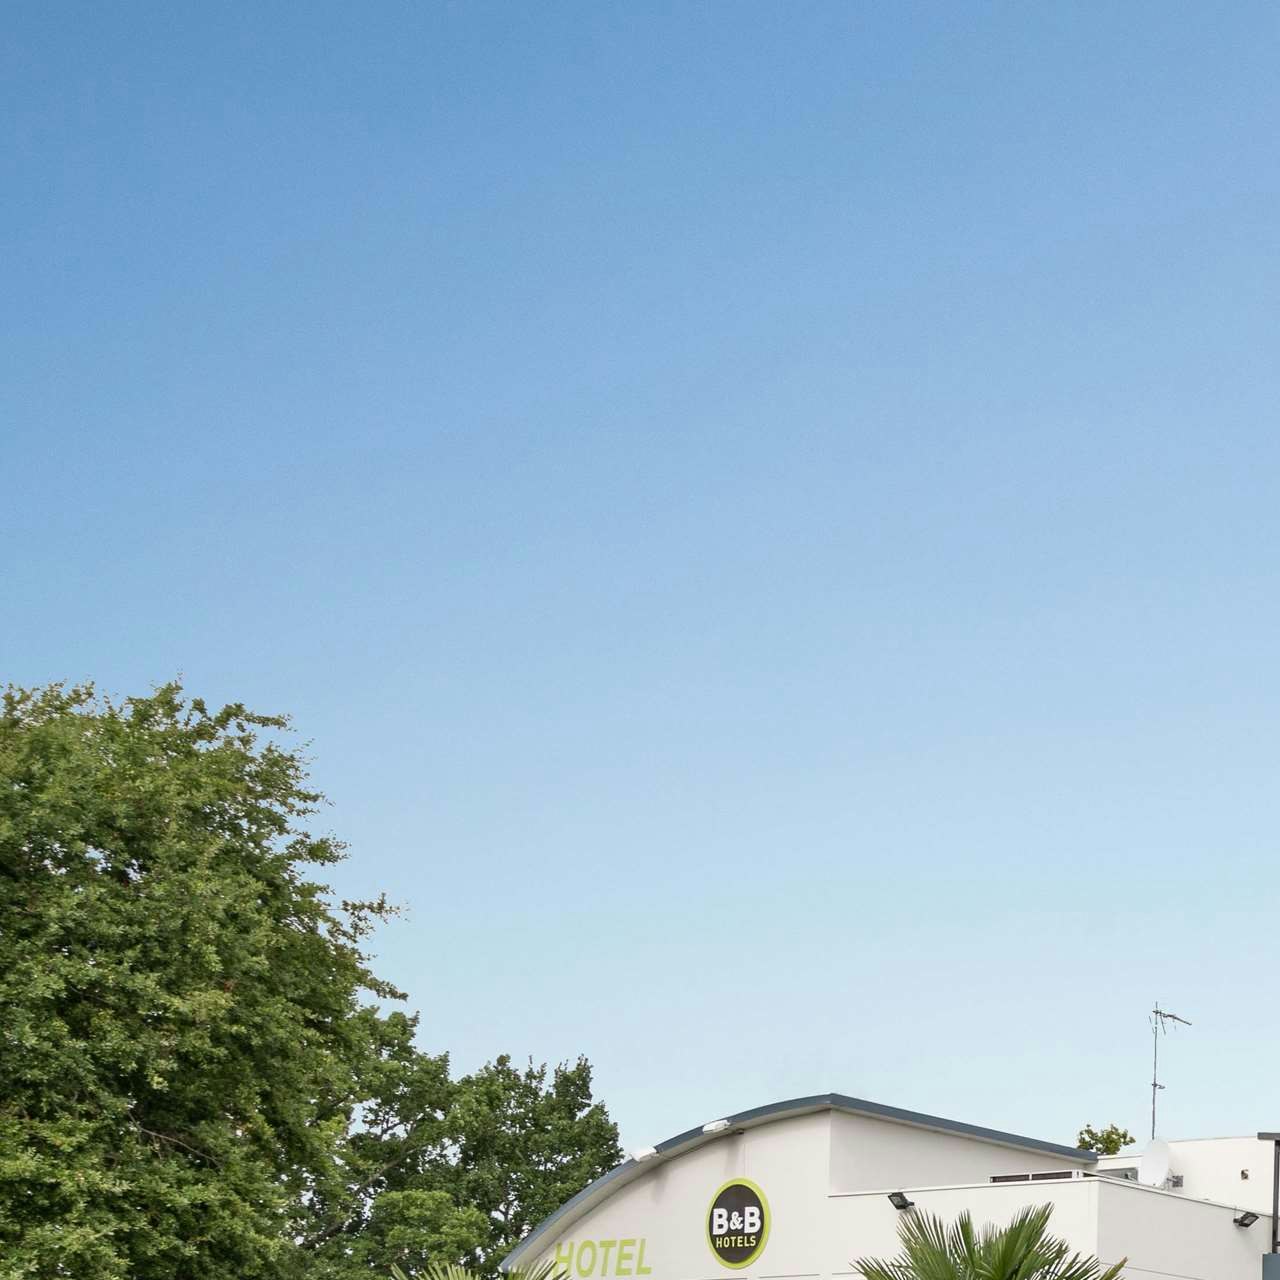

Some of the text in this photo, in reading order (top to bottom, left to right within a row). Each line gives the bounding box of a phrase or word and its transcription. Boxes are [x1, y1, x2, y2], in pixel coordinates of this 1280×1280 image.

[712, 1206, 761, 1235] B&B
[716, 1235, 756, 1248] HOTELS
[553, 1238, 653, 1278] HOTEL
